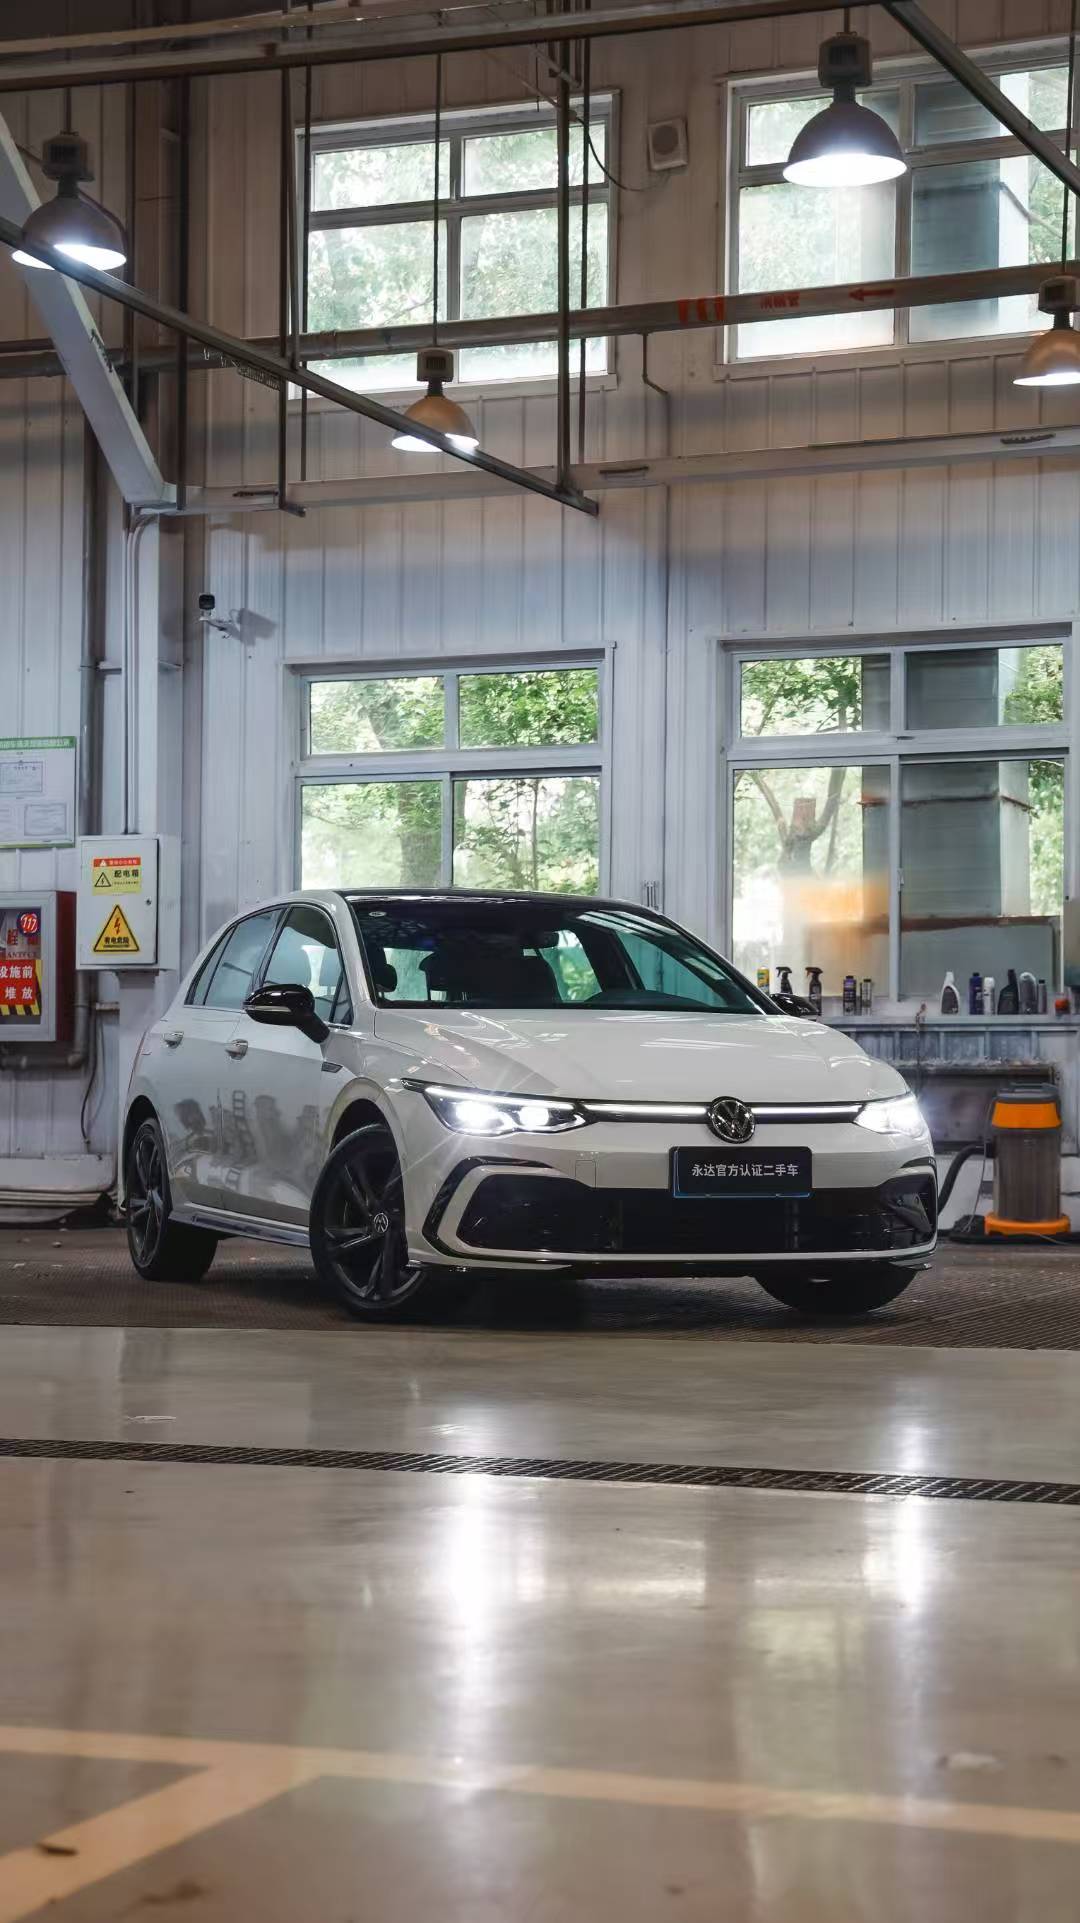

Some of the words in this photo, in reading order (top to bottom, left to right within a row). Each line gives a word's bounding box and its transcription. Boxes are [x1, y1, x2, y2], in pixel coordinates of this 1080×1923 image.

[114, 869, 139, 878] 配电箱
[104, 936, 129, 945] 有电危险
[691, 1164, 799, 1177] 永达官方认证二手车
